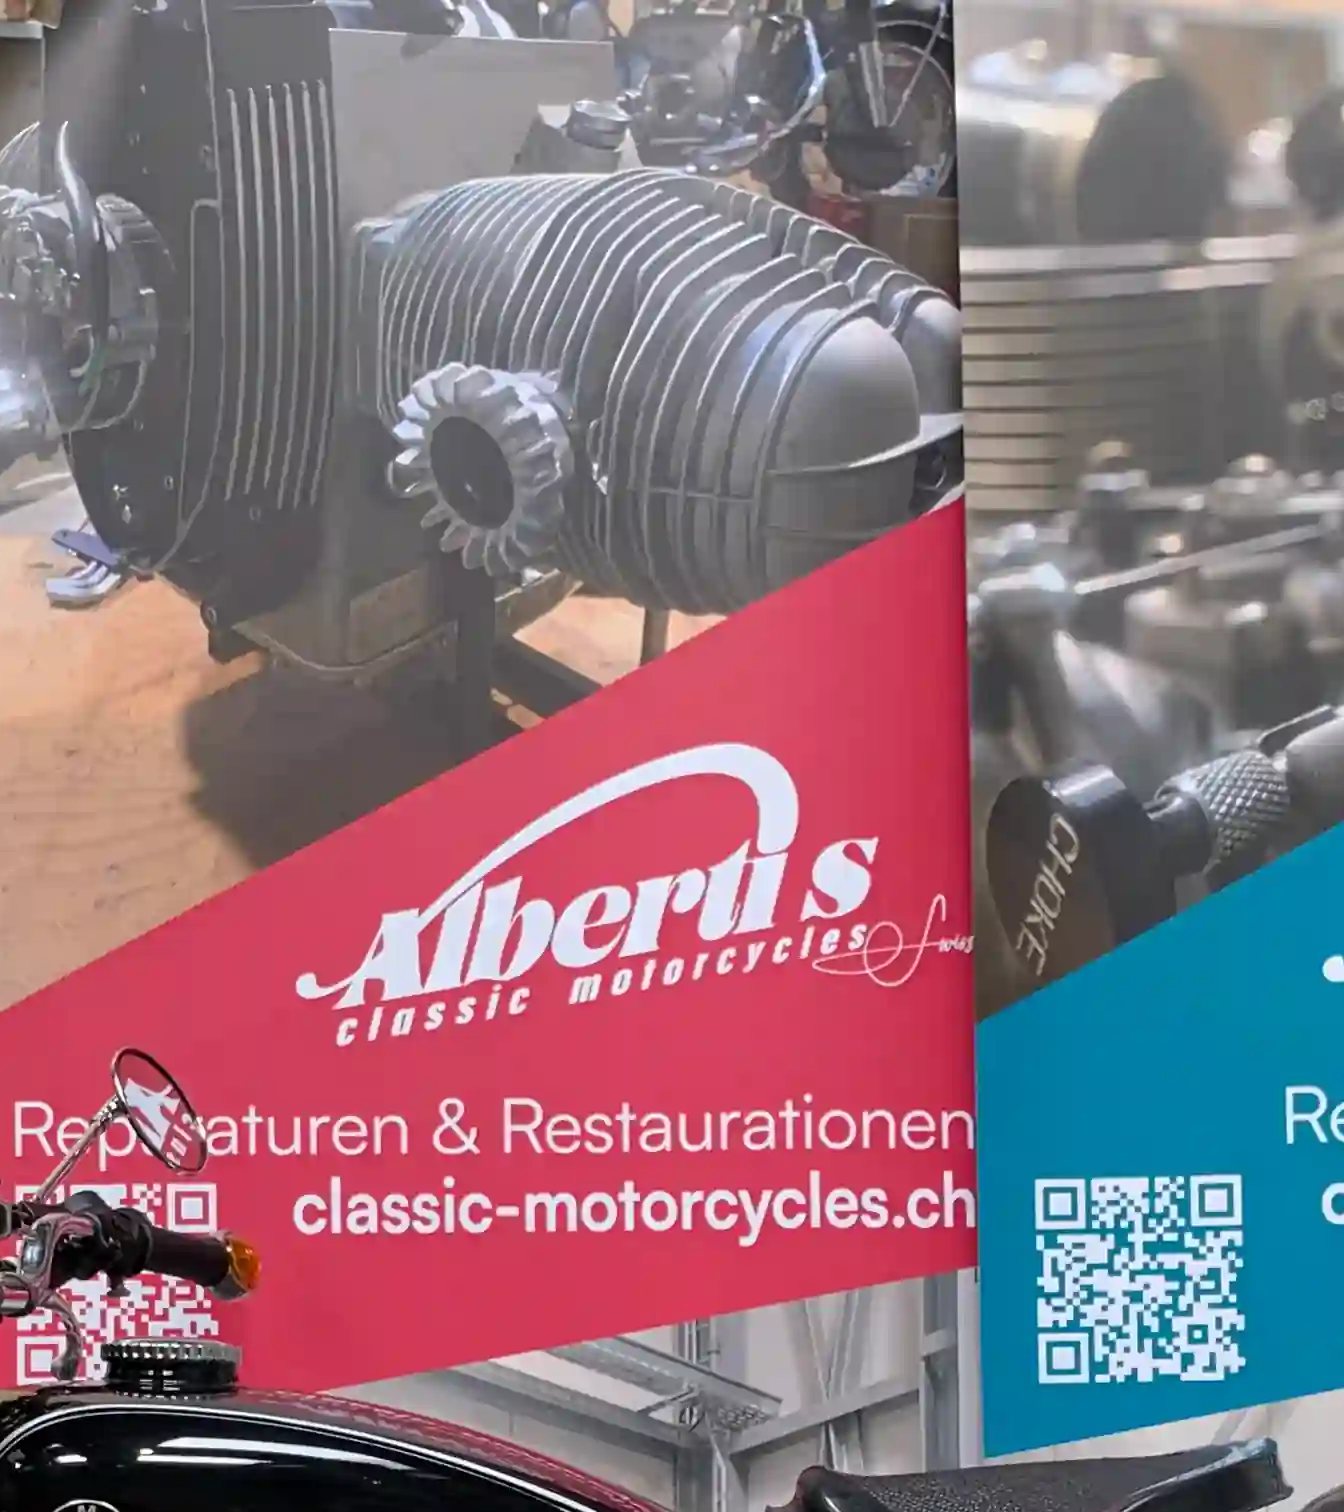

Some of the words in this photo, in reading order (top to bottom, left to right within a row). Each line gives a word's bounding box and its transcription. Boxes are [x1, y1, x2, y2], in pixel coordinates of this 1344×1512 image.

[1016, 812, 1080, 976] CHOKE
[336, 987, 530, 1047] classic
[568, 924, 869, 1005] motorcycles
[14, 1097, 408, 1172] Repaturen
[432, 1097, 481, 1155] &
[503, 1093, 975, 1154] Restaurationen
[293, 1170, 976, 1247] classic-motorcycles.ch
